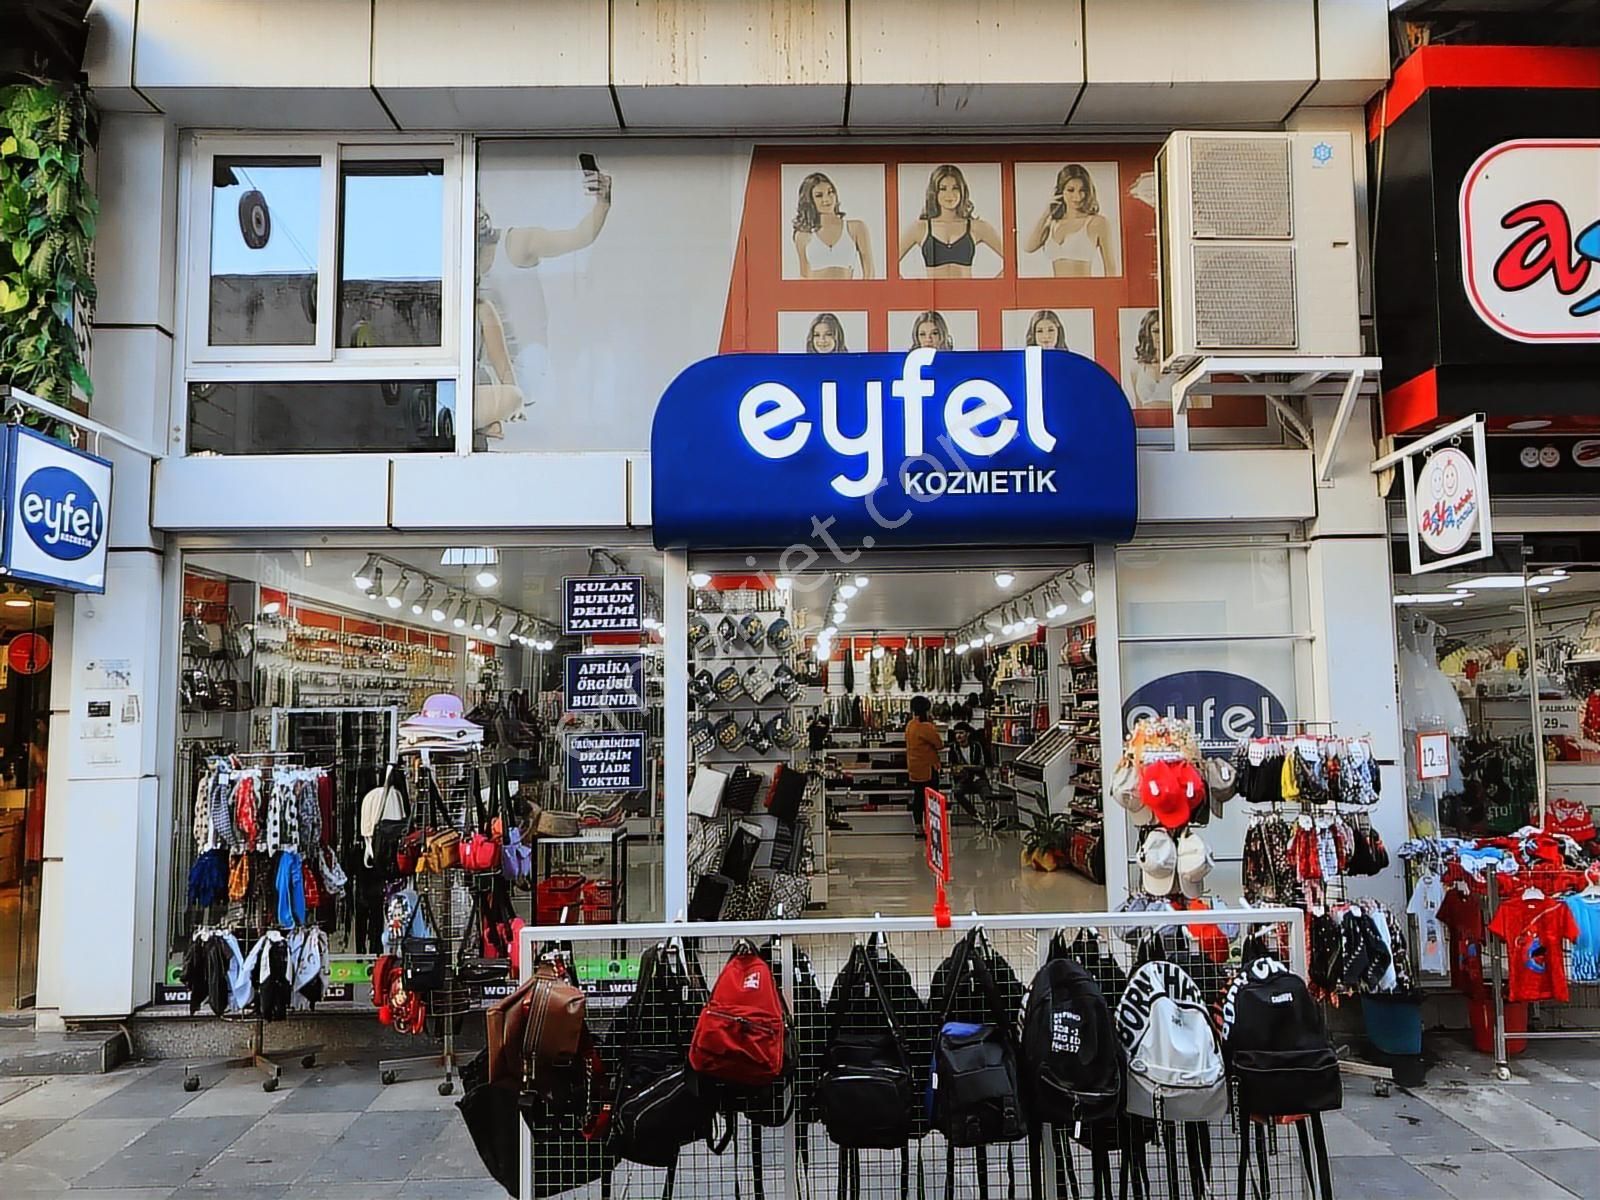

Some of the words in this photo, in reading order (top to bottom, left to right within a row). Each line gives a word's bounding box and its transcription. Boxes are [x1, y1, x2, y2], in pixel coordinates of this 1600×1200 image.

[738, 346, 1056, 498] eyfel
[904, 465, 1057, 495] KOZMETİK
[23, 493, 98, 544] eyfel
[574, 582, 633, 592] KULAK
[573, 594, 635, 604] BURUN
[572, 604, 635, 616] DELİMİ
[570, 618, 638, 629] YAPILIR
[579, 660, 630, 674] AFRİKA
[577, 676, 633, 691] ÖRGÜSÜ
[572, 694, 637, 707] BULUNUR
[582, 764, 598, 774] VE
[600, 762, 631, 774] İADE
[581, 777, 630, 787] YOKTUR
